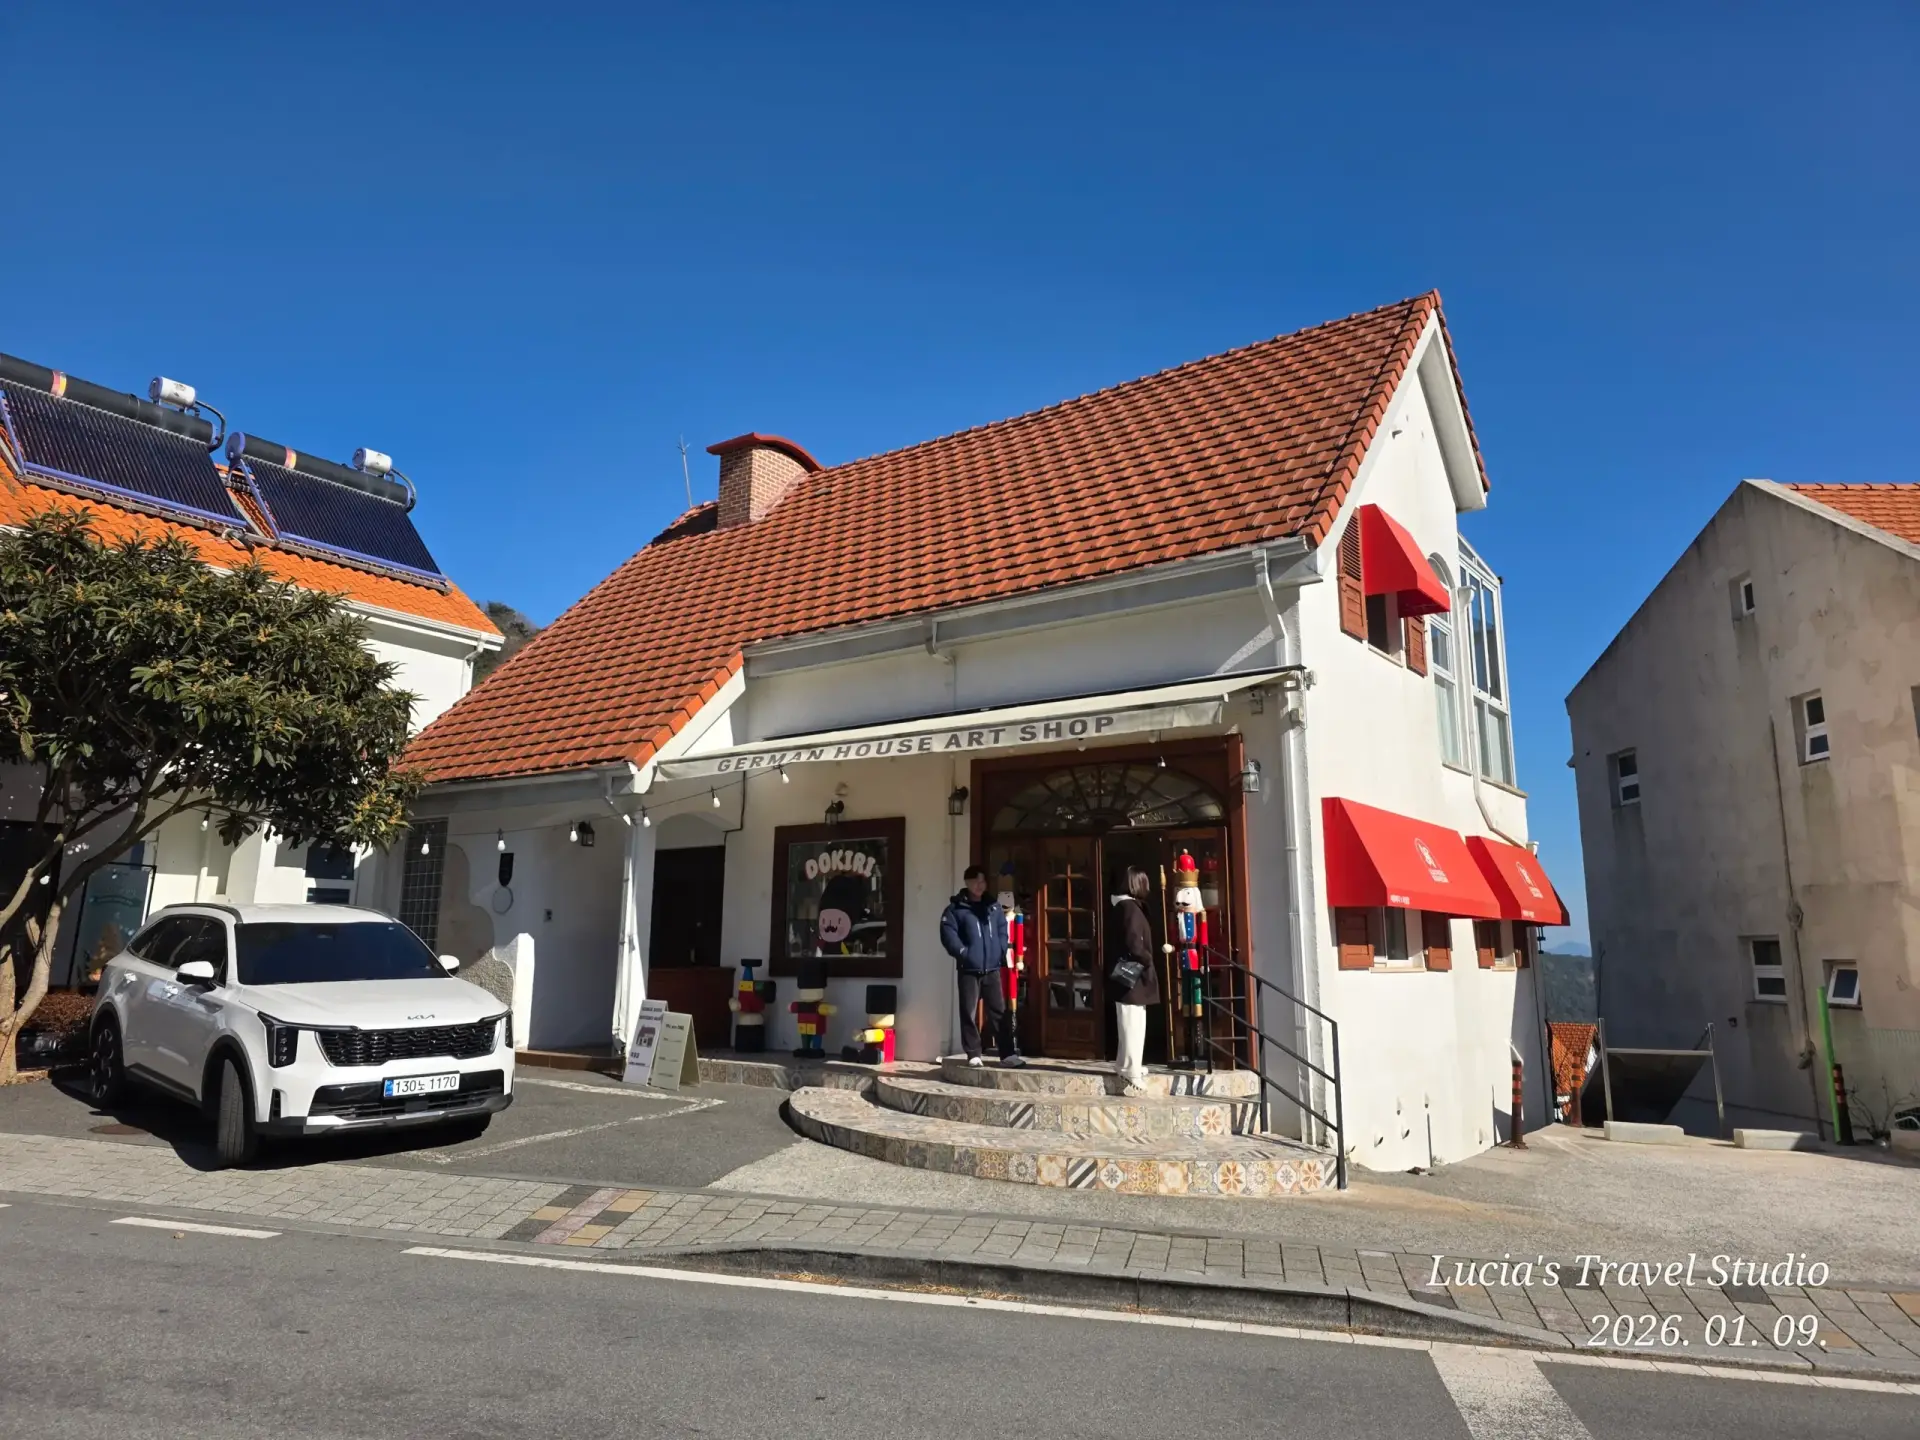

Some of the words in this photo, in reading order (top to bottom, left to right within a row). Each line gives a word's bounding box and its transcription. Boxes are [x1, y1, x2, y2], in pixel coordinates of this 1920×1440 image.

[717, 748, 825, 772] GERMAN
[833, 736, 933, 759] HOUSE
[943, 728, 1006, 749] ART
[1018, 716, 1114, 742] SHOP
[804, 848, 876, 880] DOKIRI
[429, 1075, 457, 1089] 1170
